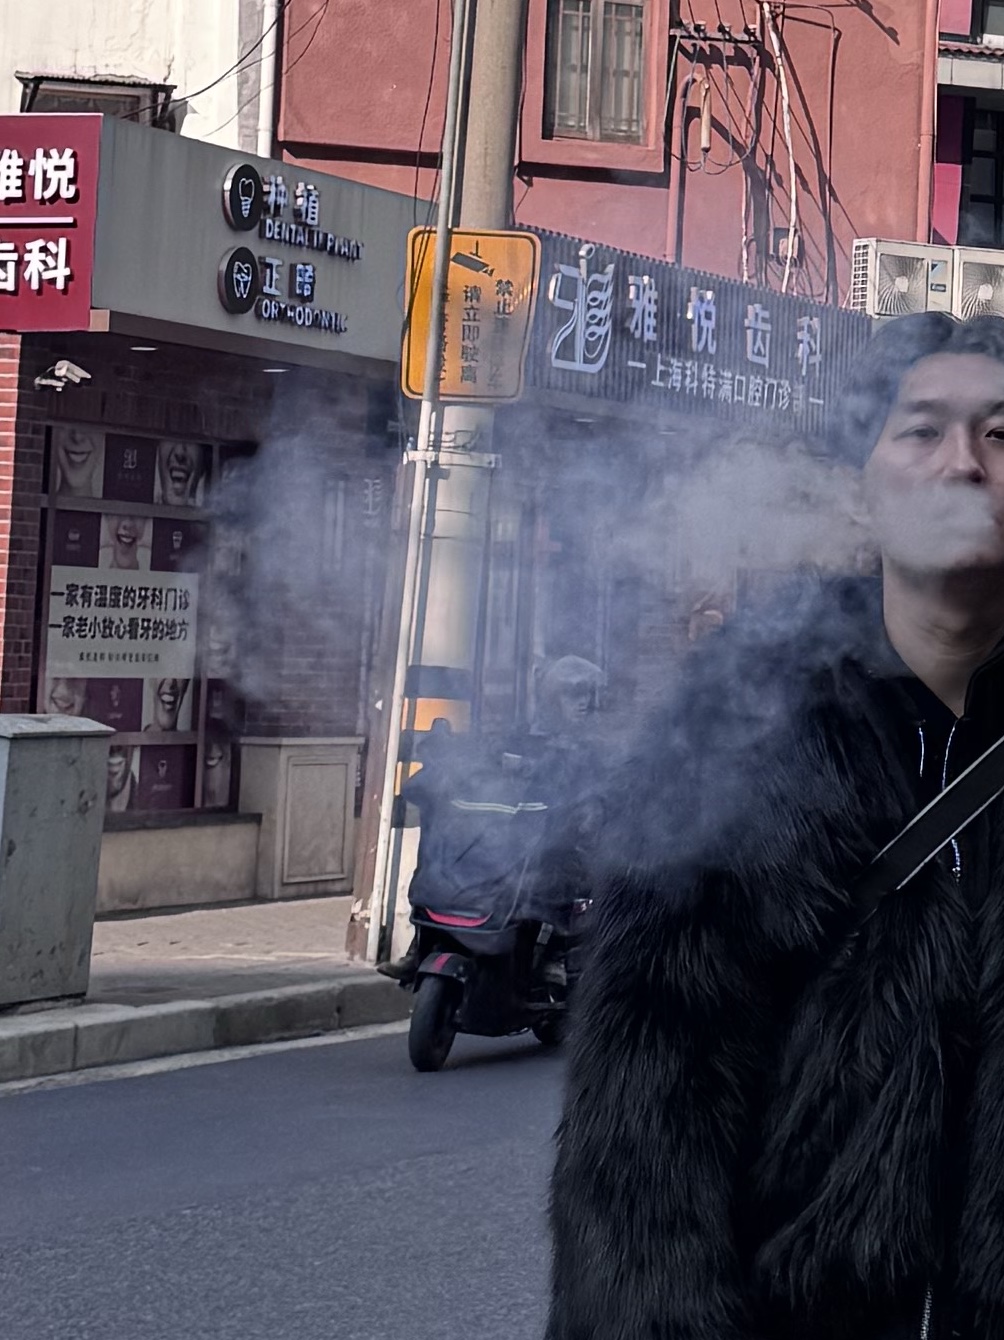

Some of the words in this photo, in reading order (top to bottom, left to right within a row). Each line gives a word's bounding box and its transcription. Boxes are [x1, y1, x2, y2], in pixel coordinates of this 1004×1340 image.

[265, 218, 309, 247] DENTAL
[628, 275, 822, 377] 雅悦齿科
[50, 583, 191, 612] 一家有温度的牙科门诊
[48, 615, 190, 642] 一家老小放心看牙的地方
